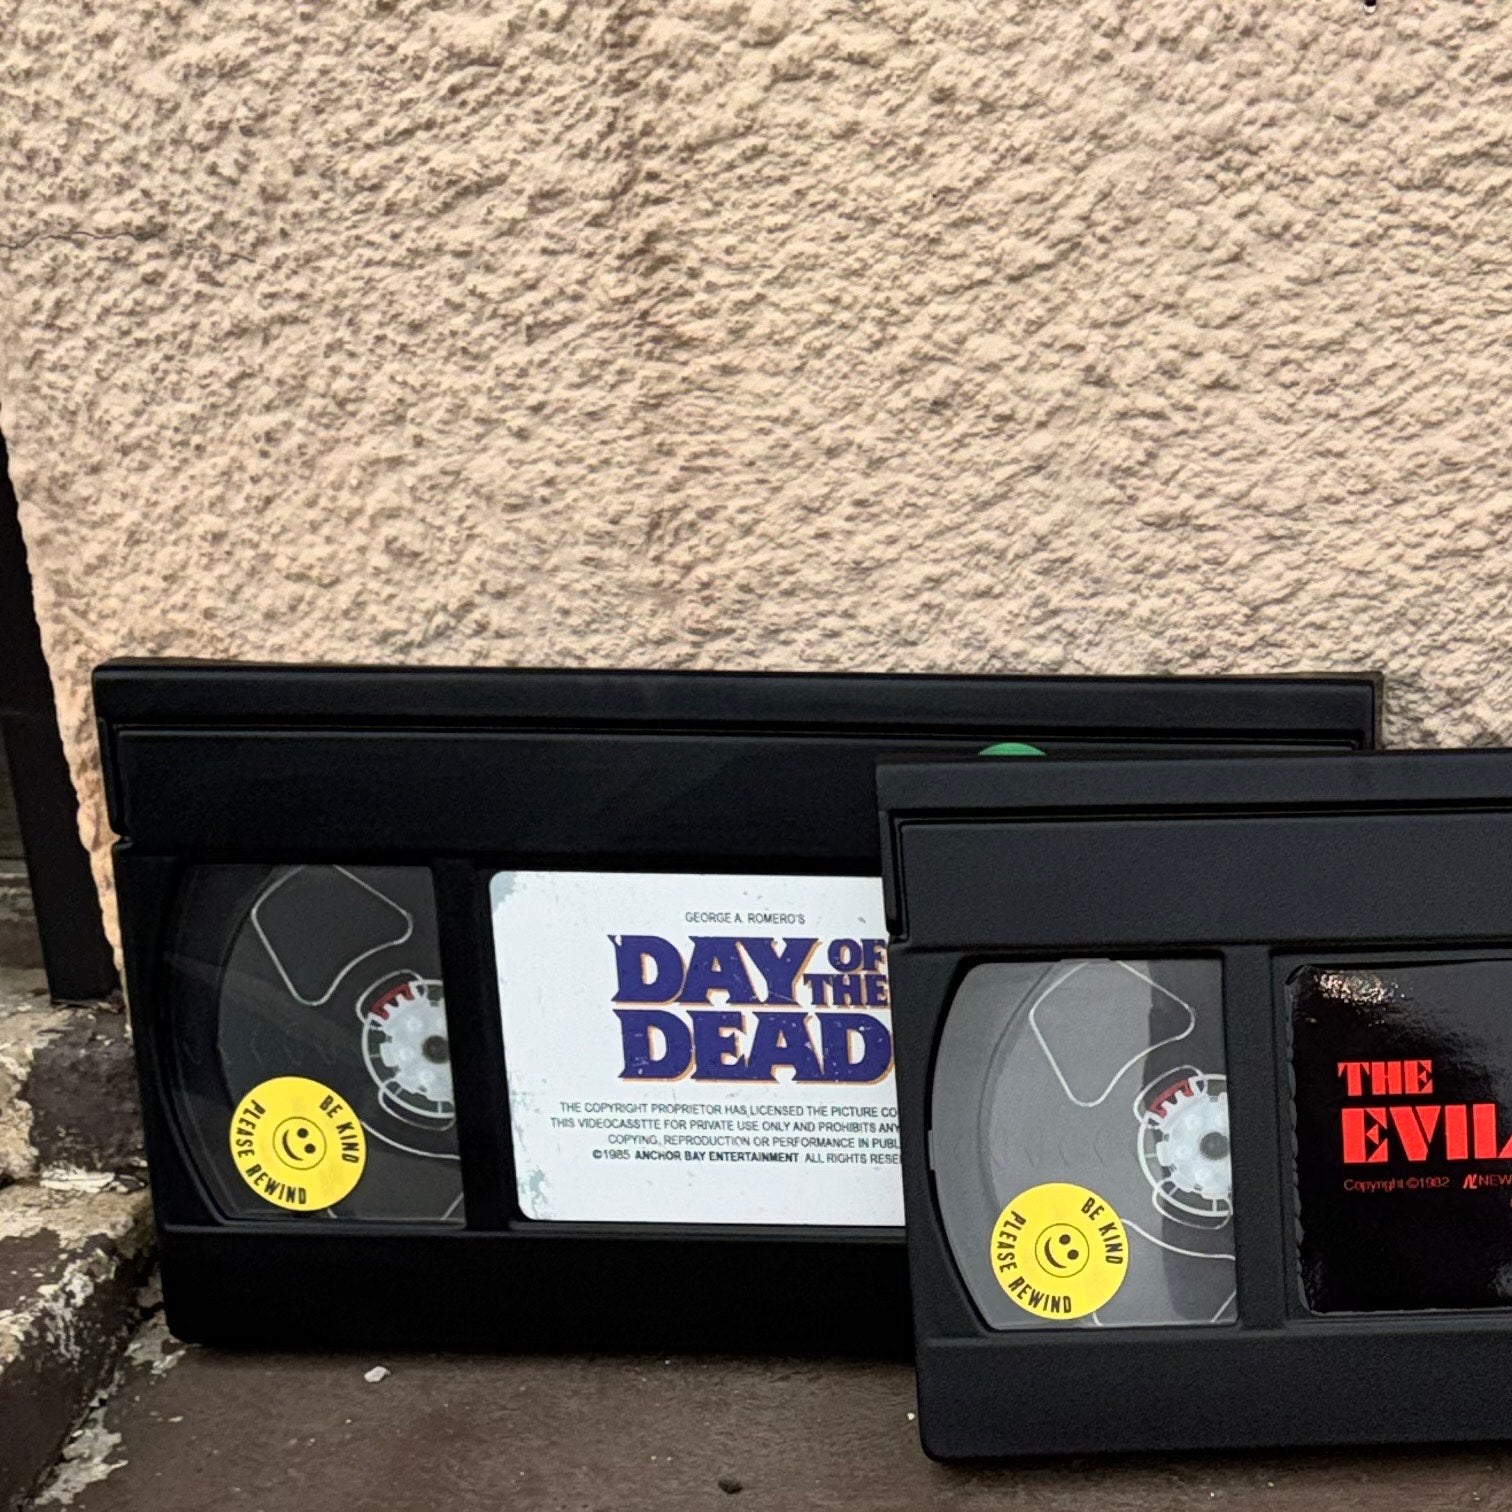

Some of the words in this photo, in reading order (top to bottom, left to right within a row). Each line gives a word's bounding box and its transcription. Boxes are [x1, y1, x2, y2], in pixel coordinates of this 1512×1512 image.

[685, 911, 731, 923] GEORGE
[747, 913, 805, 925] ROMERO'S
[608, 934, 823, 1006] DAY
[827, 938, 888, 974] OF
[803, 973, 890, 1009] THE
[613, 1009, 894, 1084] DEAD
[1337, 1059, 1433, 1096] THE
[235, 1099, 266, 1158] PLEASE
[550, 1117, 575, 1128] THIS
[664, 1119, 687, 1130] FOR
[690, 1119, 734, 1131] PRIVATE
[737, 1121, 759, 1131] USE
[762, 1121, 790, 1132] ONLY
[793, 1121, 815, 1132] AND
[819, 1122, 876, 1133] PROHIBITS
[561, 1102, 581, 1113] THE
[585, 1102, 648, 1113] COPYRIGHT
[651, 1103, 721, 1115] PROPRIETOR
[725, 1105, 747, 1115] HAS
[750, 1105, 803, 1116] LICENSED
[807, 1106, 828, 1117] THE
[832, 1106, 878, 1117] PICTURE
[319, 1094, 343, 1119] BE
[336, 1121, 360, 1164] KIND
[664, 1134, 750, 1147] REPRODUCTION
[754, 1136, 769, 1147] OR
[773, 1137, 855, 1148] PERFORMANCE
[858, 1138, 869, 1148] IN
[635, 1150, 681, 1160] ANCHOR
[685, 1150, 705, 1161] BAY
[805, 1153, 824, 1163] ALL
[827, 1153, 866, 1164] RIGHTS
[870, 1153, 901, 1164] RESE
[245, 1163, 307, 1205] REWIND
[996, 1210, 1027, 1273] PLEASE
[1080, 1196, 1105, 1221] BE
[1098, 1221, 1124, 1265] KIND
[1008, 1276, 1072, 1314] REWIND
